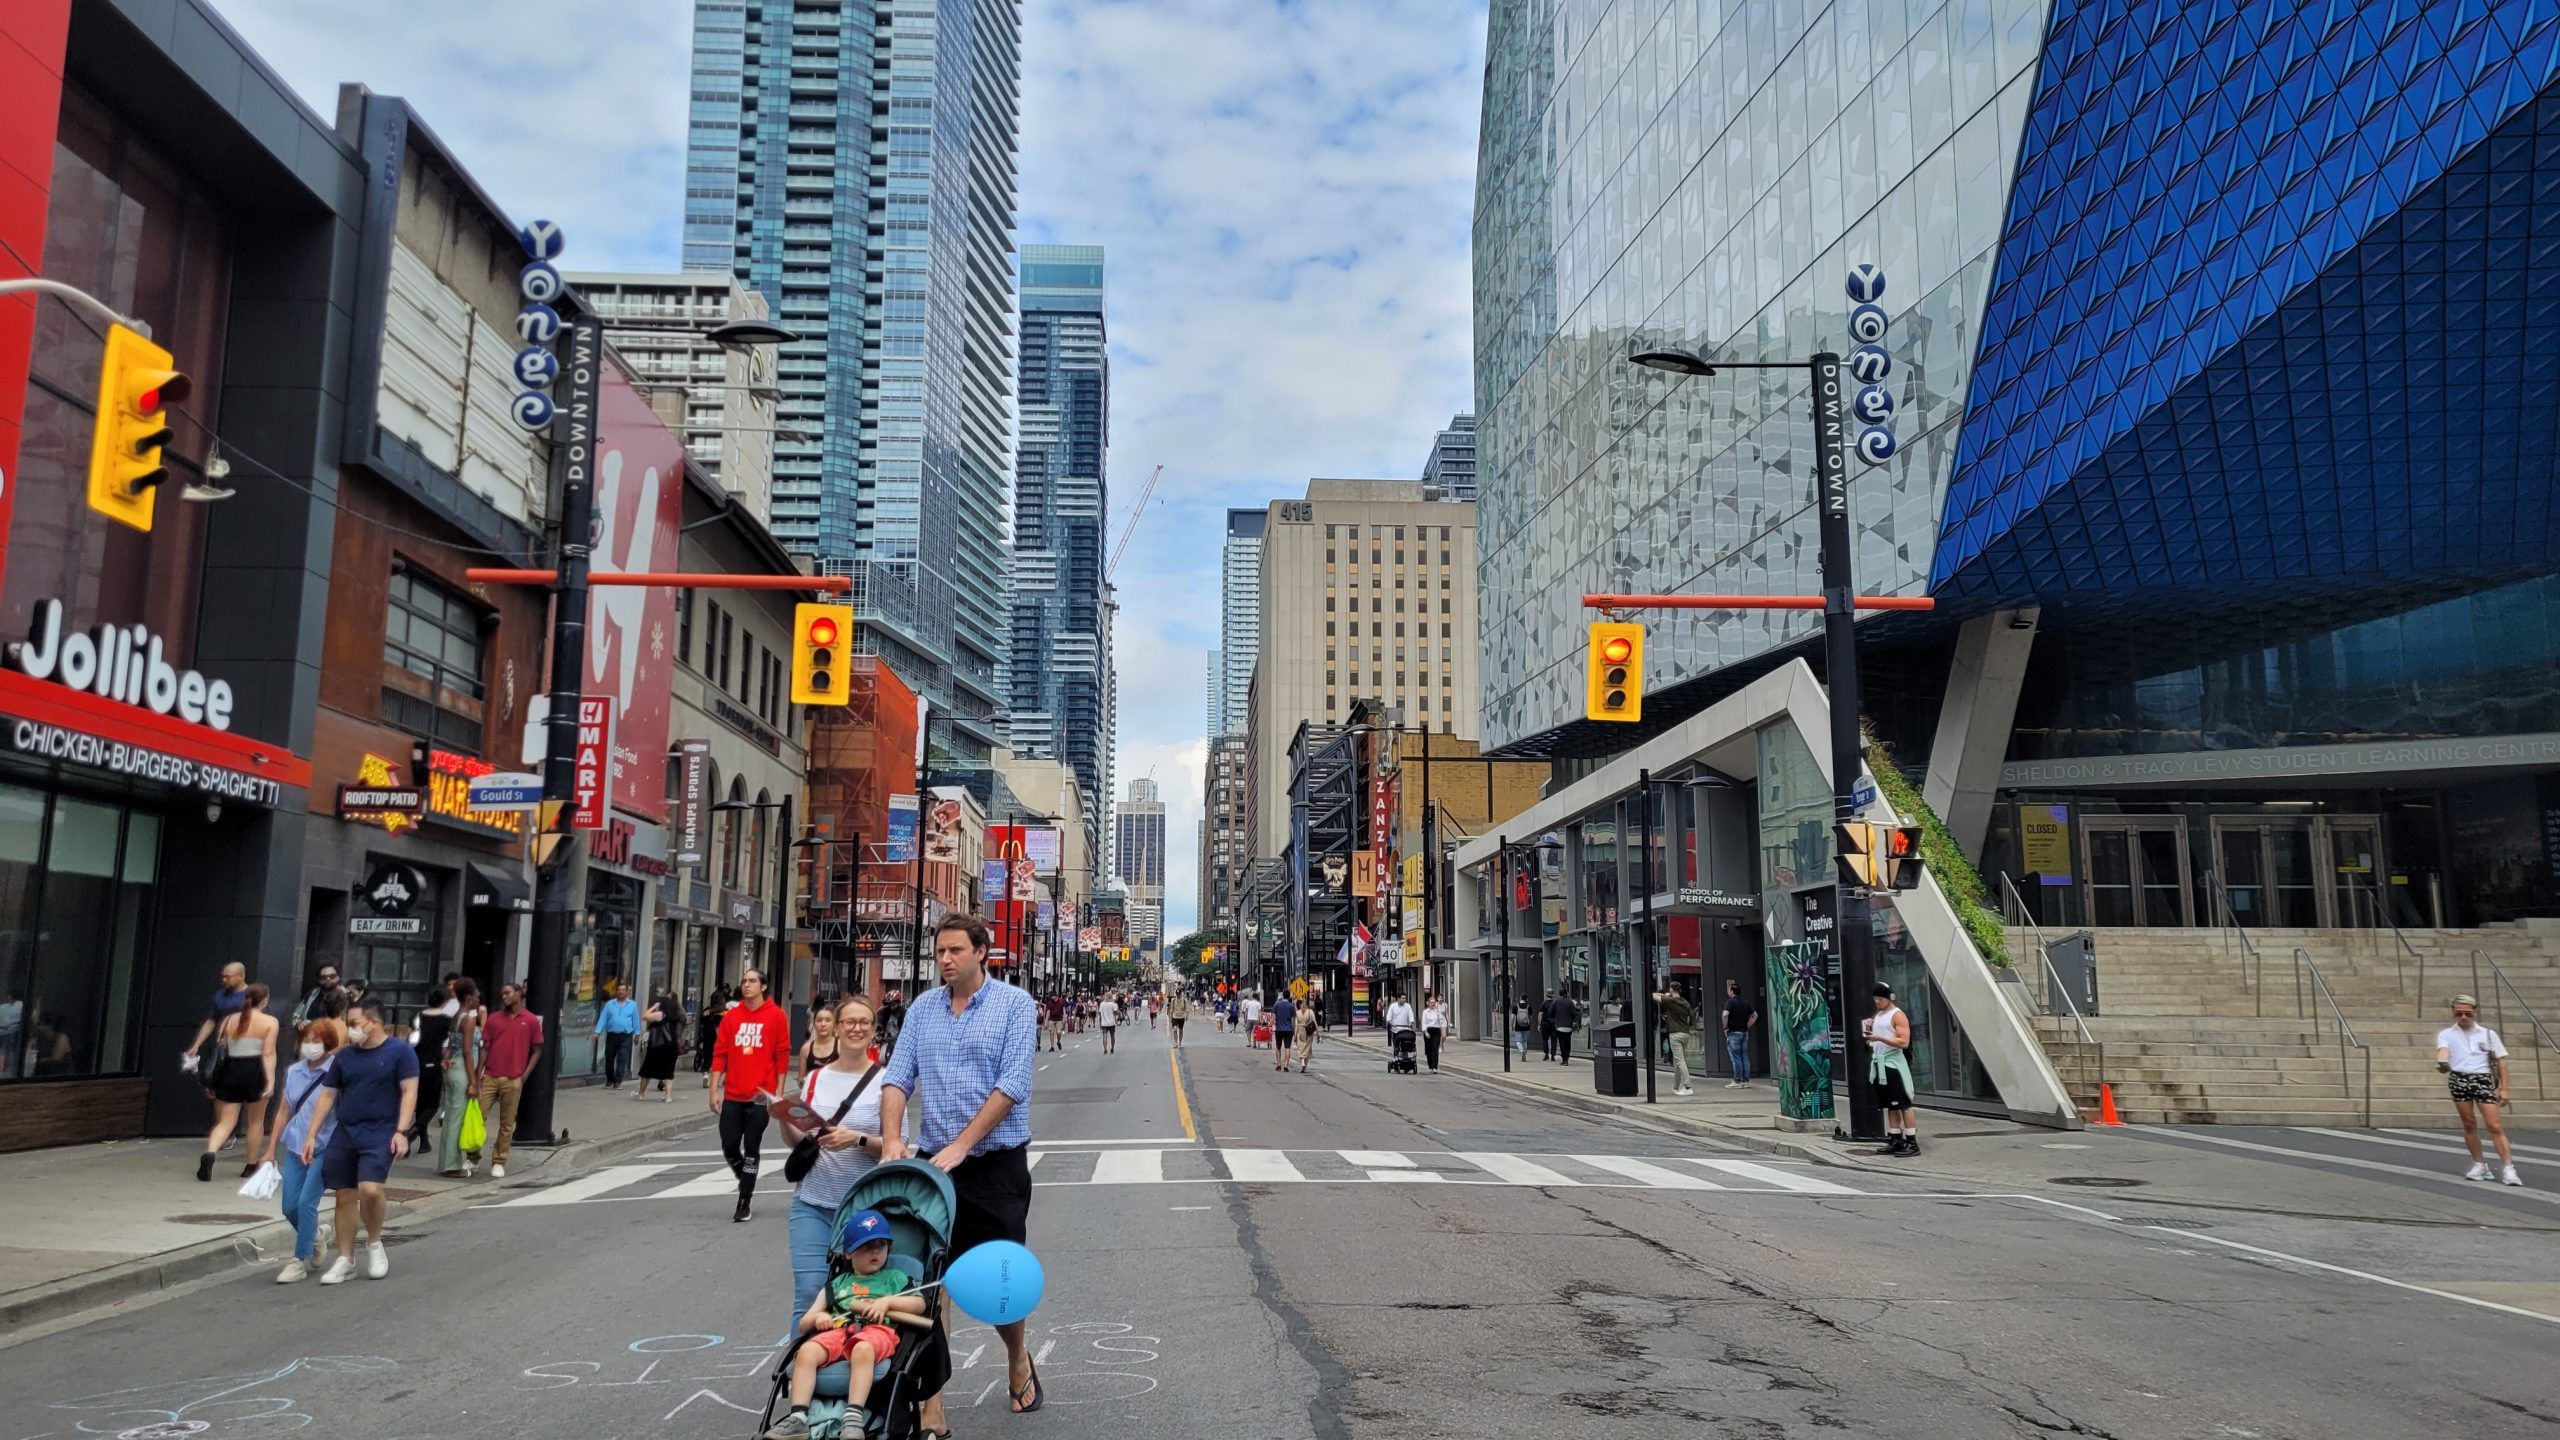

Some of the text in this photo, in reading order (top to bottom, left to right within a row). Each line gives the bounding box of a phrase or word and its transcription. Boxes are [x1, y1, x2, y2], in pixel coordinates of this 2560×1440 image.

[512, 221, 562, 432] Yonge
[1847, 263, 1896, 466] Yonge
[567, 325, 593, 482] DOWNTOWN
[1822, 365, 1846, 510] DOWNTOWN
[1280, 502, 1313, 522] 415
[20, 598, 233, 731] Jollibee
[14, 720, 280, 805] CHICKEN BURGERS SPAGHETTI
[578, 727, 600, 808] MART
[2004, 741, 2560, 783] SHELDON & TRACY LEVY STUDENT LEARNING CENTR
[345, 791, 418, 806] ROOFTOP PATIO
[480, 789, 524, 801] Gould St
[684, 755, 700, 849] CHAMPS SPORTS
[2026, 824, 2058, 834] CLOSED
[1376, 781, 1386, 909] ZANZIBAR
[473, 895, 489, 905] BAR
[1680, 888, 1711, 896] SCHOOL
[1680, 896, 1754, 907] PERFORMANCE
[1805, 897, 1818, 911] The
[356, 919, 415, 931] EAT DRINK
[1805, 914, 1833, 932] Creative
[1382, 949, 1398, 960] 40
[738, 1022, 764, 1035] JUST
[734, 1034, 750, 1047] DO
[998, 1295, 1010, 1314] Tom
